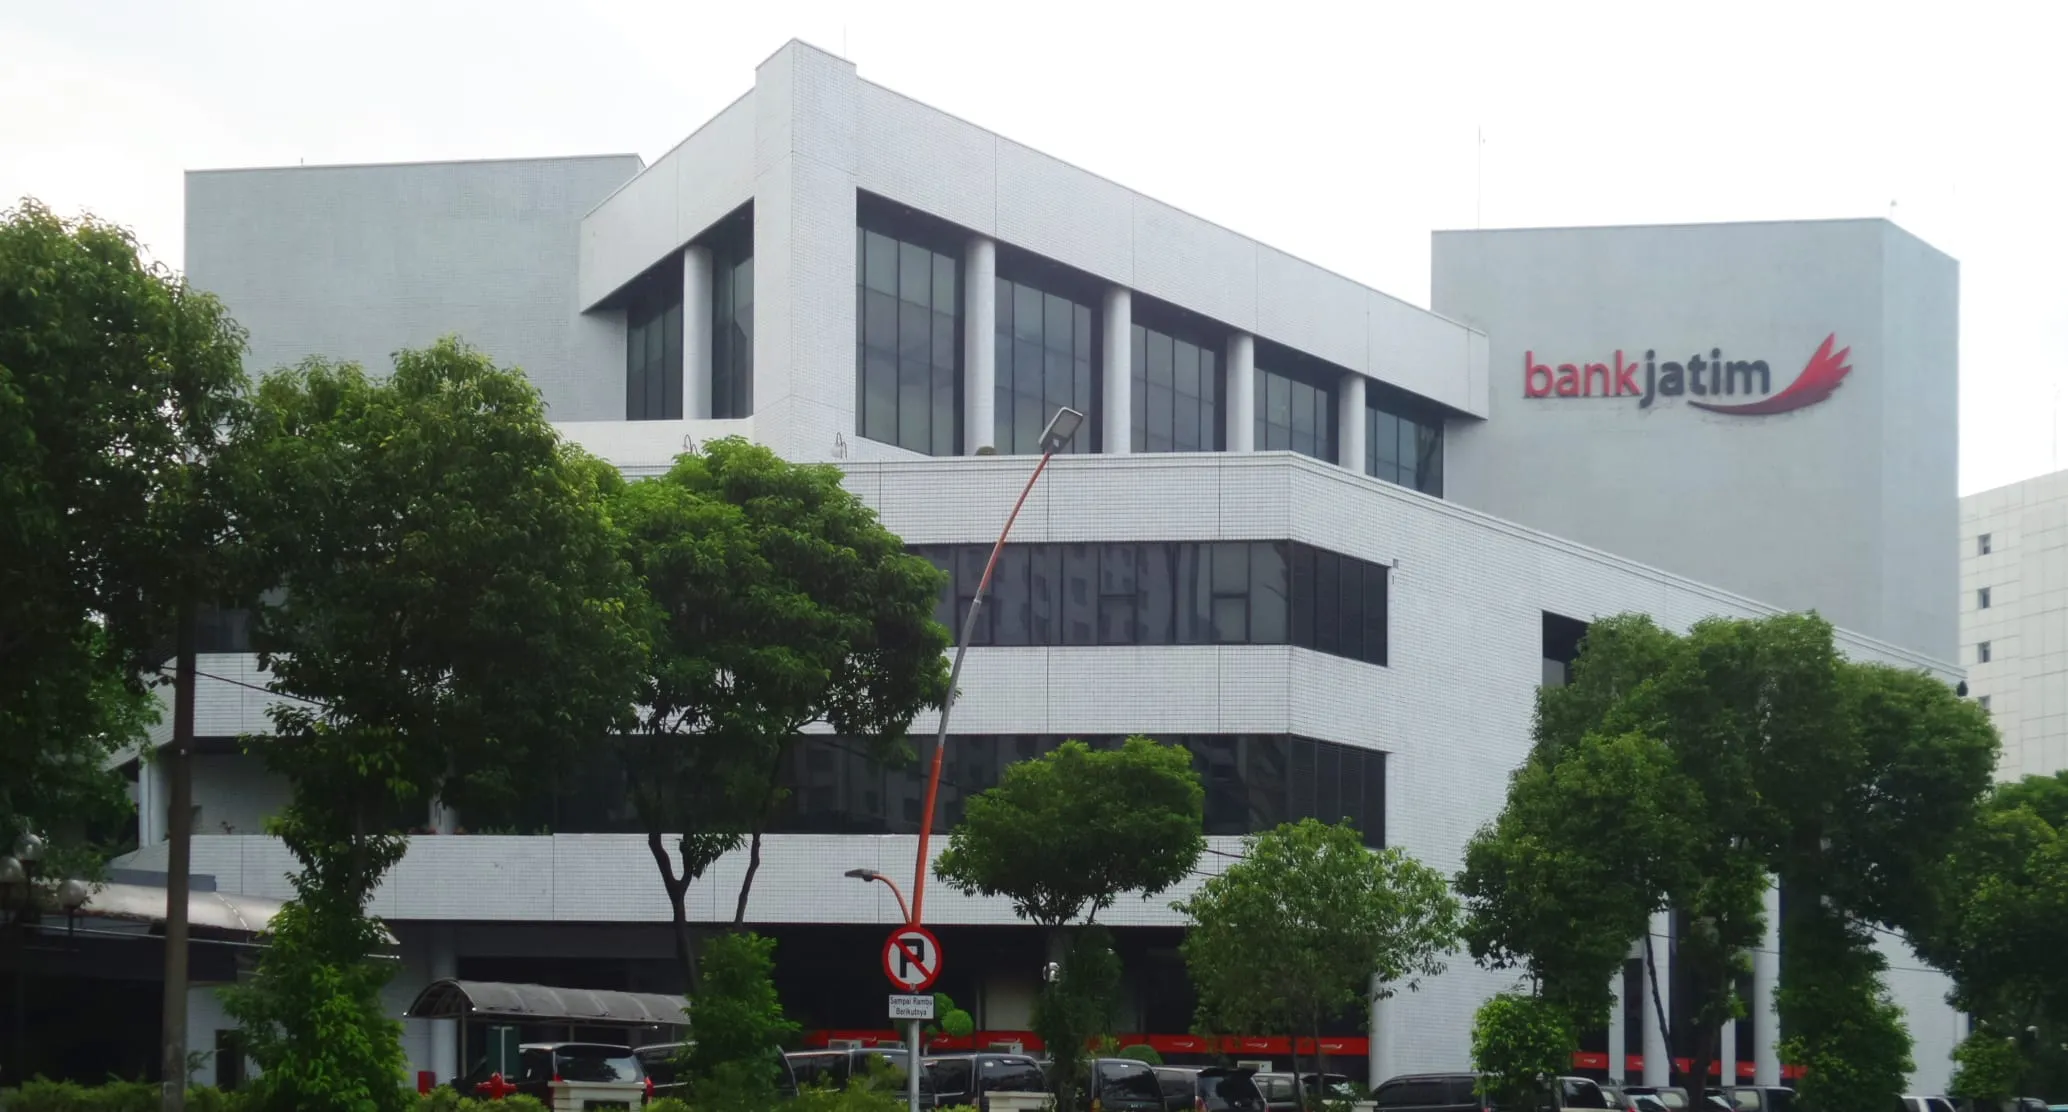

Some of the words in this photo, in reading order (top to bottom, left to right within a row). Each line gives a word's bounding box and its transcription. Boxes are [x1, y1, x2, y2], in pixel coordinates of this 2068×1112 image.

[1524, 348, 1770, 409] bankjatim
[899, 938, 925, 978] P
[890, 997, 911, 1005] Sampai
[913, 997, 933, 1005] Rambu
[896, 1007, 927, 1017] Berikutnya
